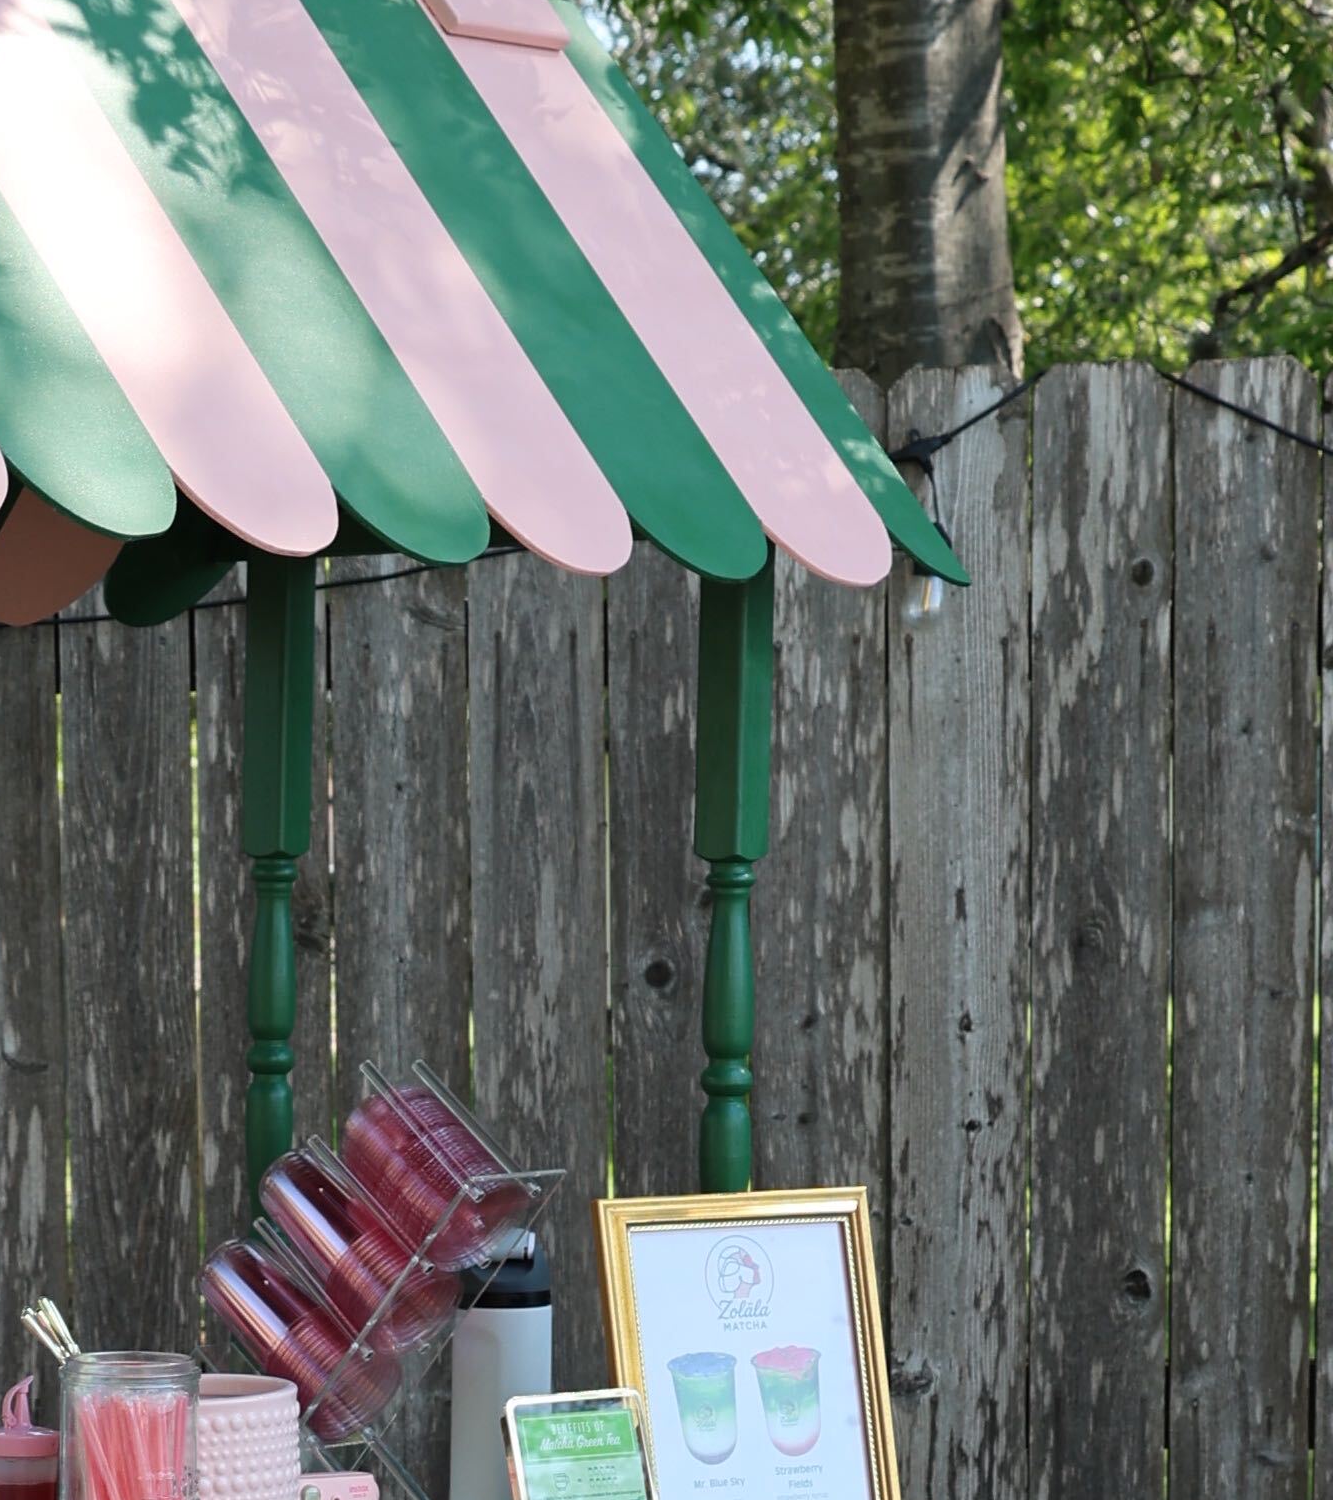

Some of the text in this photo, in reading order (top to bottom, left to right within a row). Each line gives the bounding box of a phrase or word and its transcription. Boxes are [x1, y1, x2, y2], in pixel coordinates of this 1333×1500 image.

[723, 1320, 768, 1332] MATCHA
[550, 1420, 604, 1435] BENEFITS OF
[540, 1432, 621, 1451] Matcha Green Tea
[774, 1464, 822, 1476] Strawberry
[709, 1478, 728, 1488] Blue
[730, 1477, 745, 1487] Sky
[788, 1478, 813, 1489] Fields
